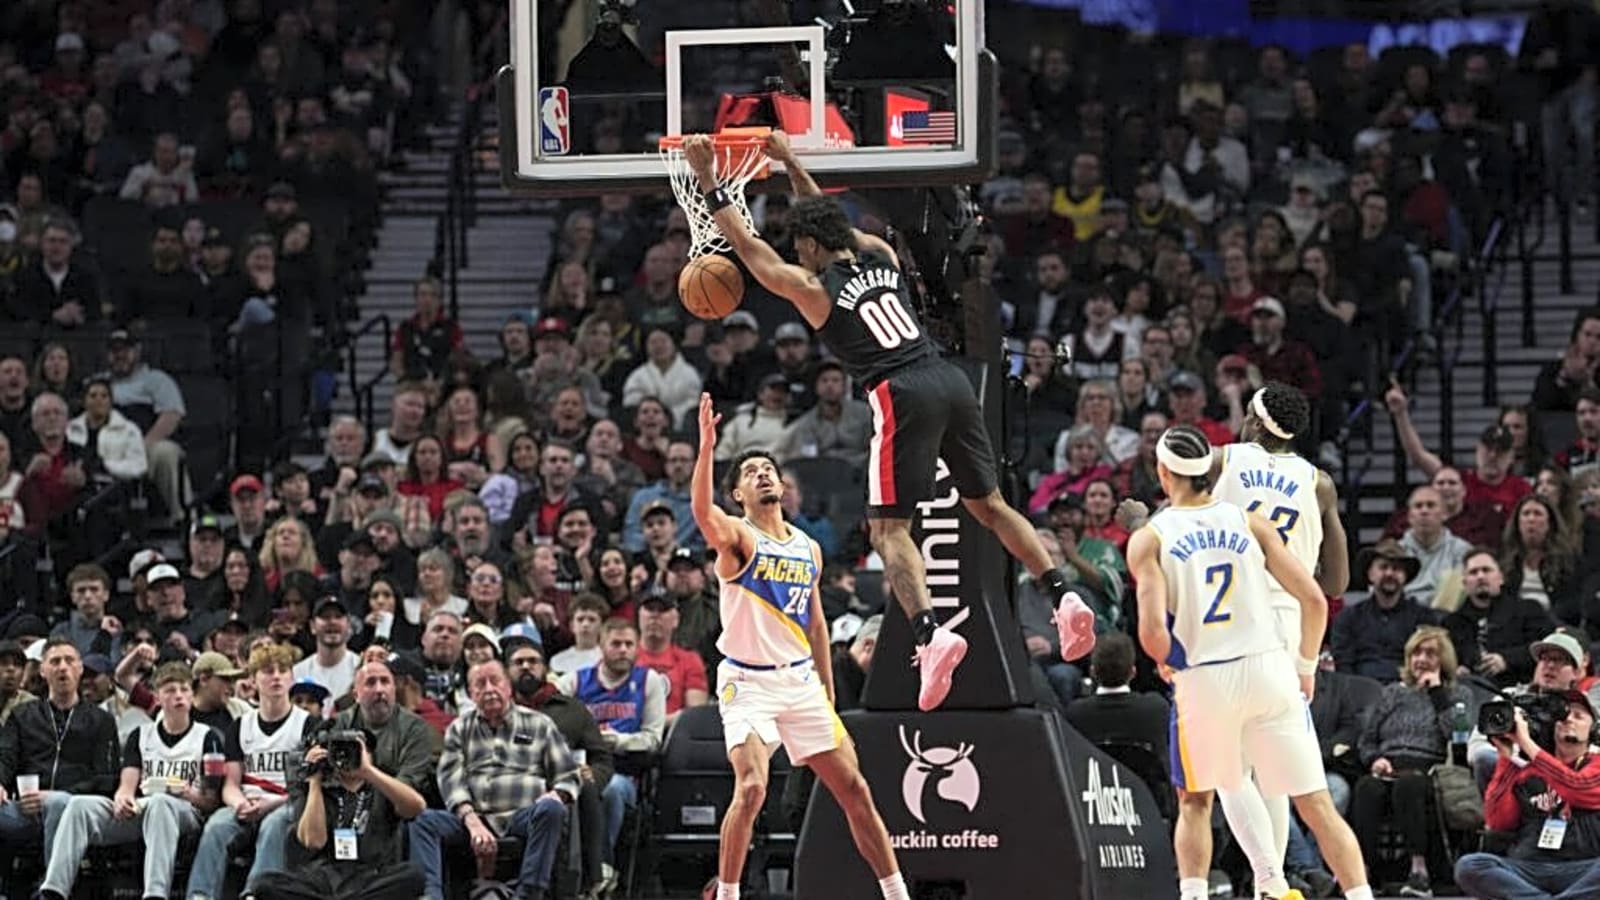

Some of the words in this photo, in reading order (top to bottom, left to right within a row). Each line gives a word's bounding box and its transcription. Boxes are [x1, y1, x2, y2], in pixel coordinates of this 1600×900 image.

[836, 268, 899, 311] HENDERSON
[859, 292, 920, 349] 00
[1239, 469, 1300, 498] SIAKAM
[1246, 500, 1300, 546] 3
[752, 555, 813, 586] PACERS
[783, 586, 812, 616] 26
[1203, 562, 1235, 626] 2
[889, 830, 937, 849] uckin
[942, 830, 999, 849] coffee
[1100, 845, 1146, 869] AIRLINES
